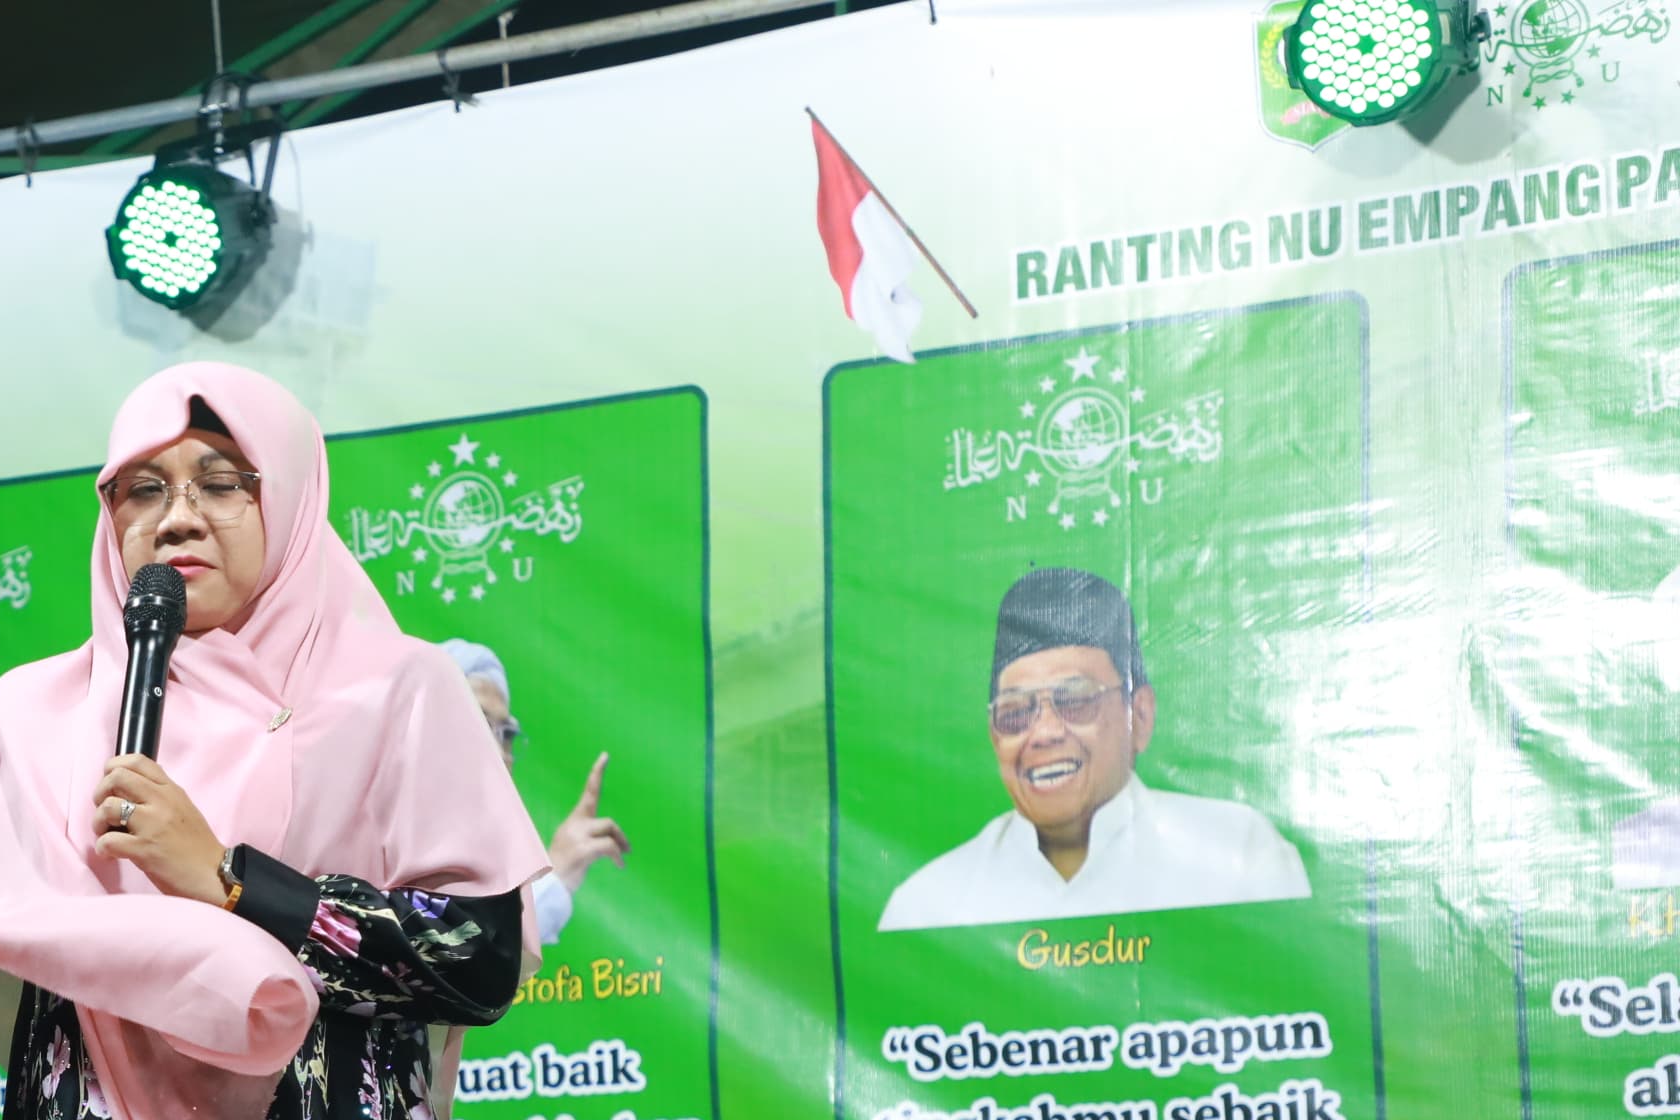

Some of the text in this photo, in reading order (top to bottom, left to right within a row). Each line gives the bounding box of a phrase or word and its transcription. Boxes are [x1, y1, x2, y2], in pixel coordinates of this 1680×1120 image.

[1016, 220, 1252, 299] RANTING
[1268, 206, 1342, 263] NU
[1358, 164, 1600, 250] EMPANG
[1007, 477, 1164, 522] N U
[396, 557, 534, 595] N U
[1017, 925, 1151, 970] Gusdur
[590, 956, 664, 999] Bisri
[1559, 981, 1680, 1029] “Sel
[889, 1015, 1324, 1073] “Sebenar apapun
[540, 1047, 638, 1089] baik
